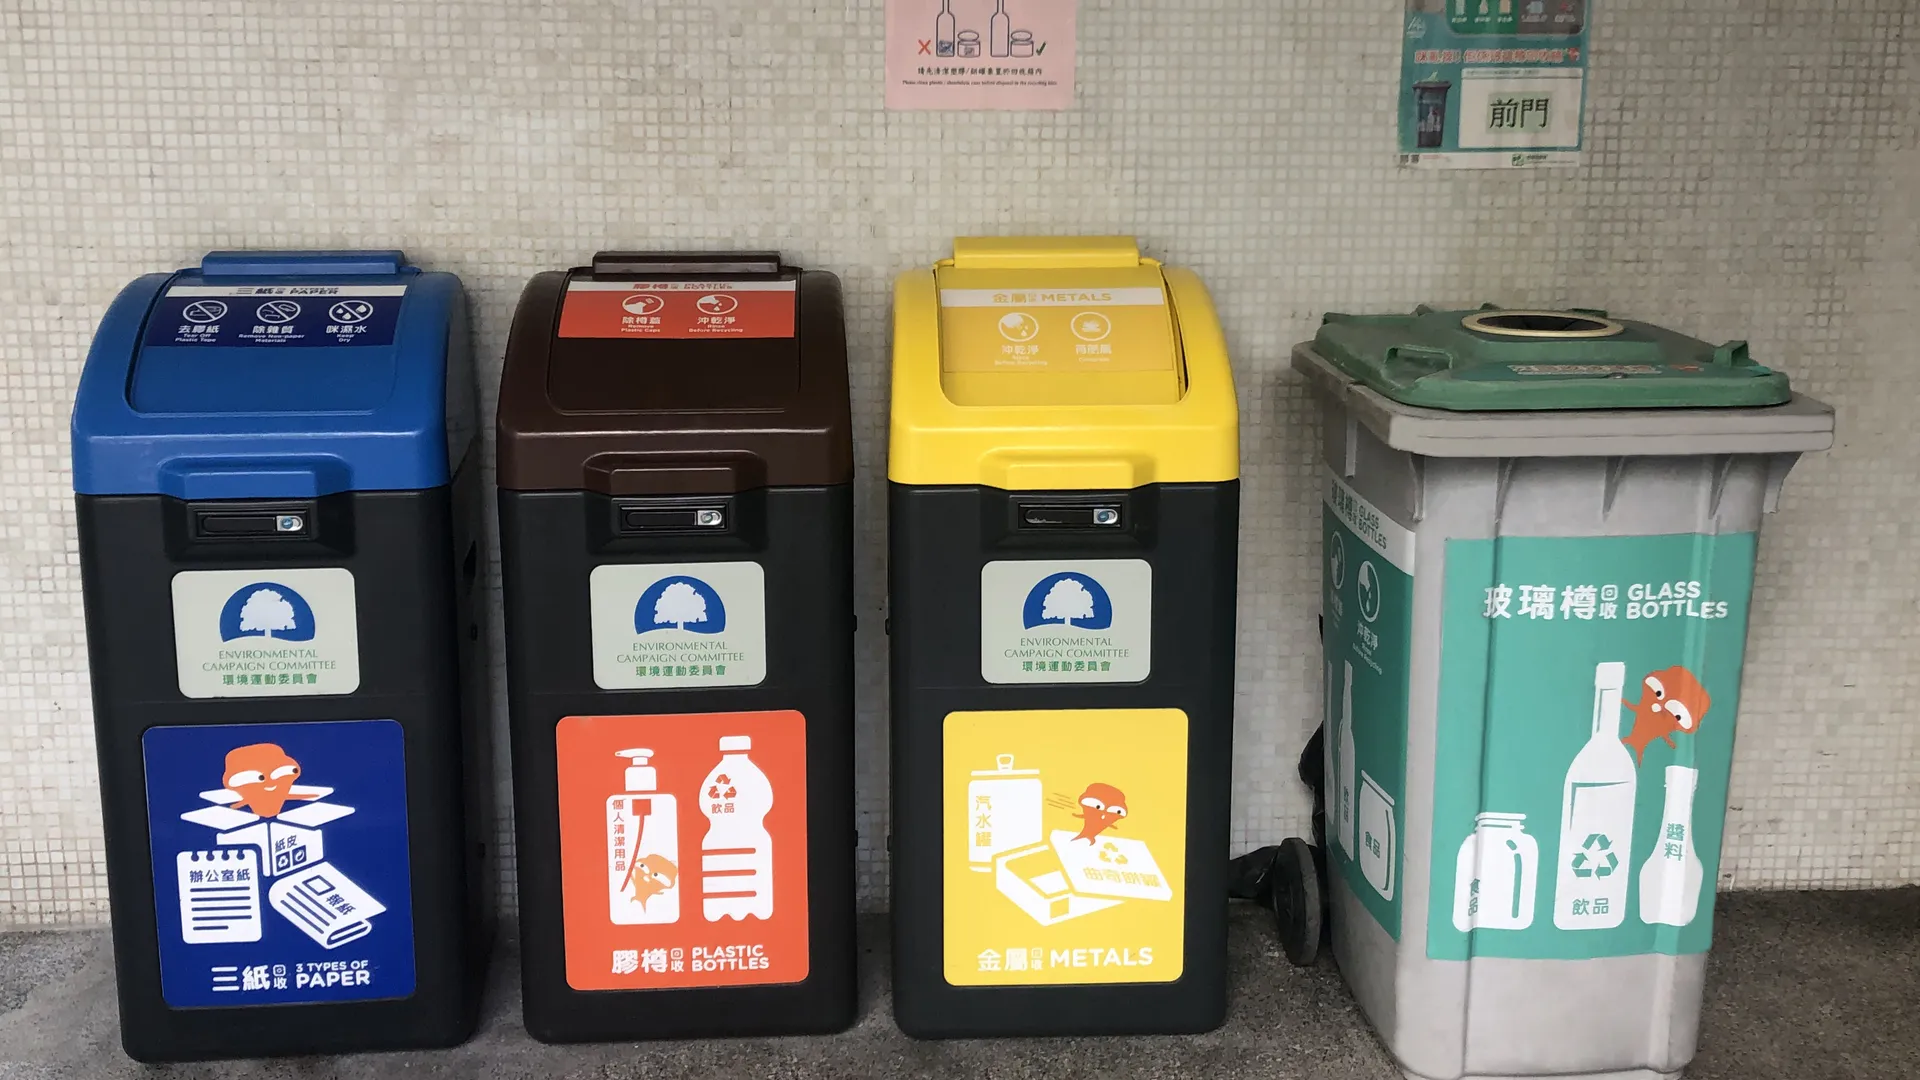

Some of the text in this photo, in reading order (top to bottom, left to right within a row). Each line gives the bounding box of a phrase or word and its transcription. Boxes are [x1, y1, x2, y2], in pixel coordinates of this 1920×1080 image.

[1490, 98, 1550, 129] 前門
[1041, 293, 1112, 302] METALS
[178, 325, 220, 334] 去膠紙
[252, 325, 294, 335] 除雜質
[326, 325, 367, 334] 咪濕水
[1359, 505, 1380, 529] GLASS
[1359, 519, 1387, 550] BOTTLES
[1627, 581, 1702, 600] GLASS
[1627, 600, 1728, 620] BOTTLES
[633, 641, 728, 652] ENVIRONMENTAL
[1020, 637, 1113, 647] ENVIRONMENTAL
[219, 649, 318, 660] ENVIRONMENTAL
[616, 652, 745, 664] CAMPAIGN COMMITTEE
[1004, 648, 1130, 659] CAMPAIGN COMMITTEE
[202, 660, 336, 671] CAMPAIGN COMMITTEE
[635, 664, 727, 677] 環境運動委員會
[1022, 660, 1111, 672] 環境運動委員會
[222, 673, 317, 686] 環境運動委員會
[711, 802, 735, 814] 飲品
[975, 795, 992, 848] 汽水罐
[611, 798, 627, 872] 個人清潔用品
[1663, 822, 1685, 862] 醬料
[274, 835, 297, 853] 紙皮
[1364, 831, 1381, 859] 食品
[189, 868, 251, 884] 辦公室紙
[325, 892, 356, 916] 報紙
[1571, 897, 1610, 915] 飲品
[692, 945, 764, 958] PLASTIC
[1050, 947, 1153, 968] METALS
[296, 960, 369, 972] 3 TYPES OF
[692, 957, 769, 972] BOTTLES
[296, 970, 371, 989] PAPER
